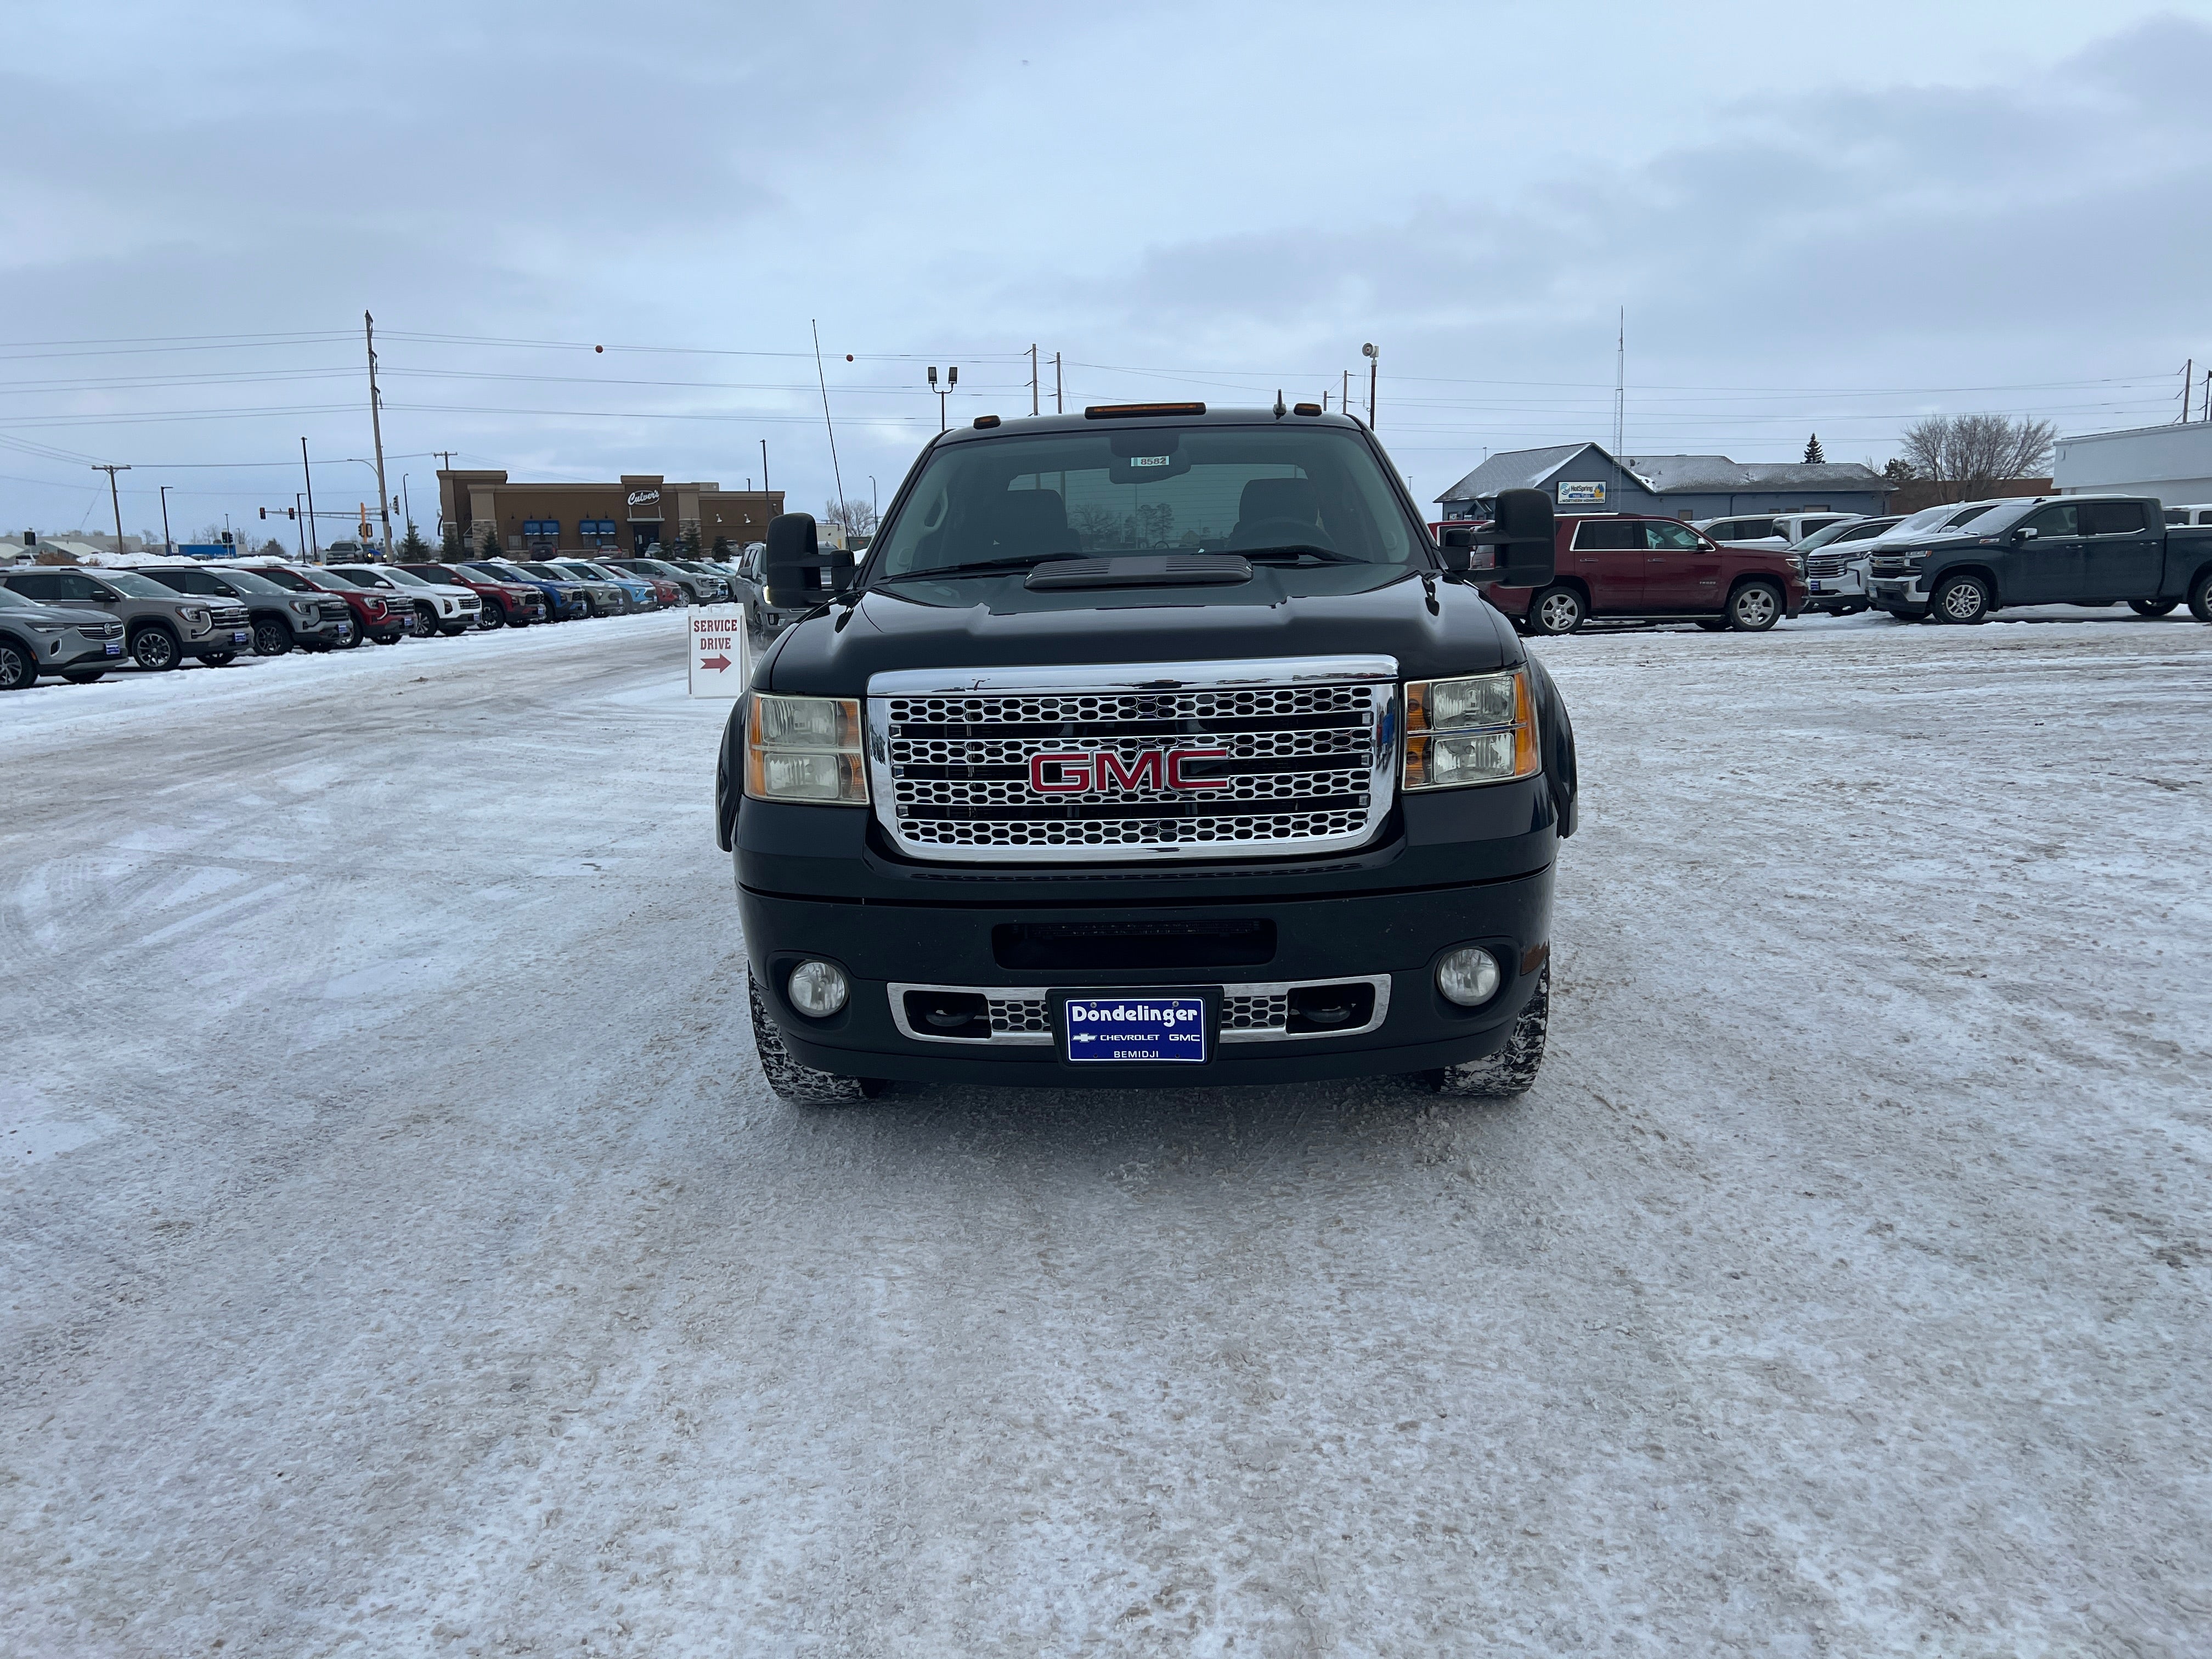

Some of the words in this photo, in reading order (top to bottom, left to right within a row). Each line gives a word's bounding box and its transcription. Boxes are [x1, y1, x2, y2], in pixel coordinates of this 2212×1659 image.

[1141, 457, 1166, 465] 8582
[627, 489, 660, 505] Culver's
[693, 619, 737, 633] SERVICE
[700, 637, 731, 650] DRIVE
[1029, 746, 1231, 794] GMC
[1071, 1005, 1198, 1028] Dondelinger
[1169, 1034, 1200, 1042] GMC
